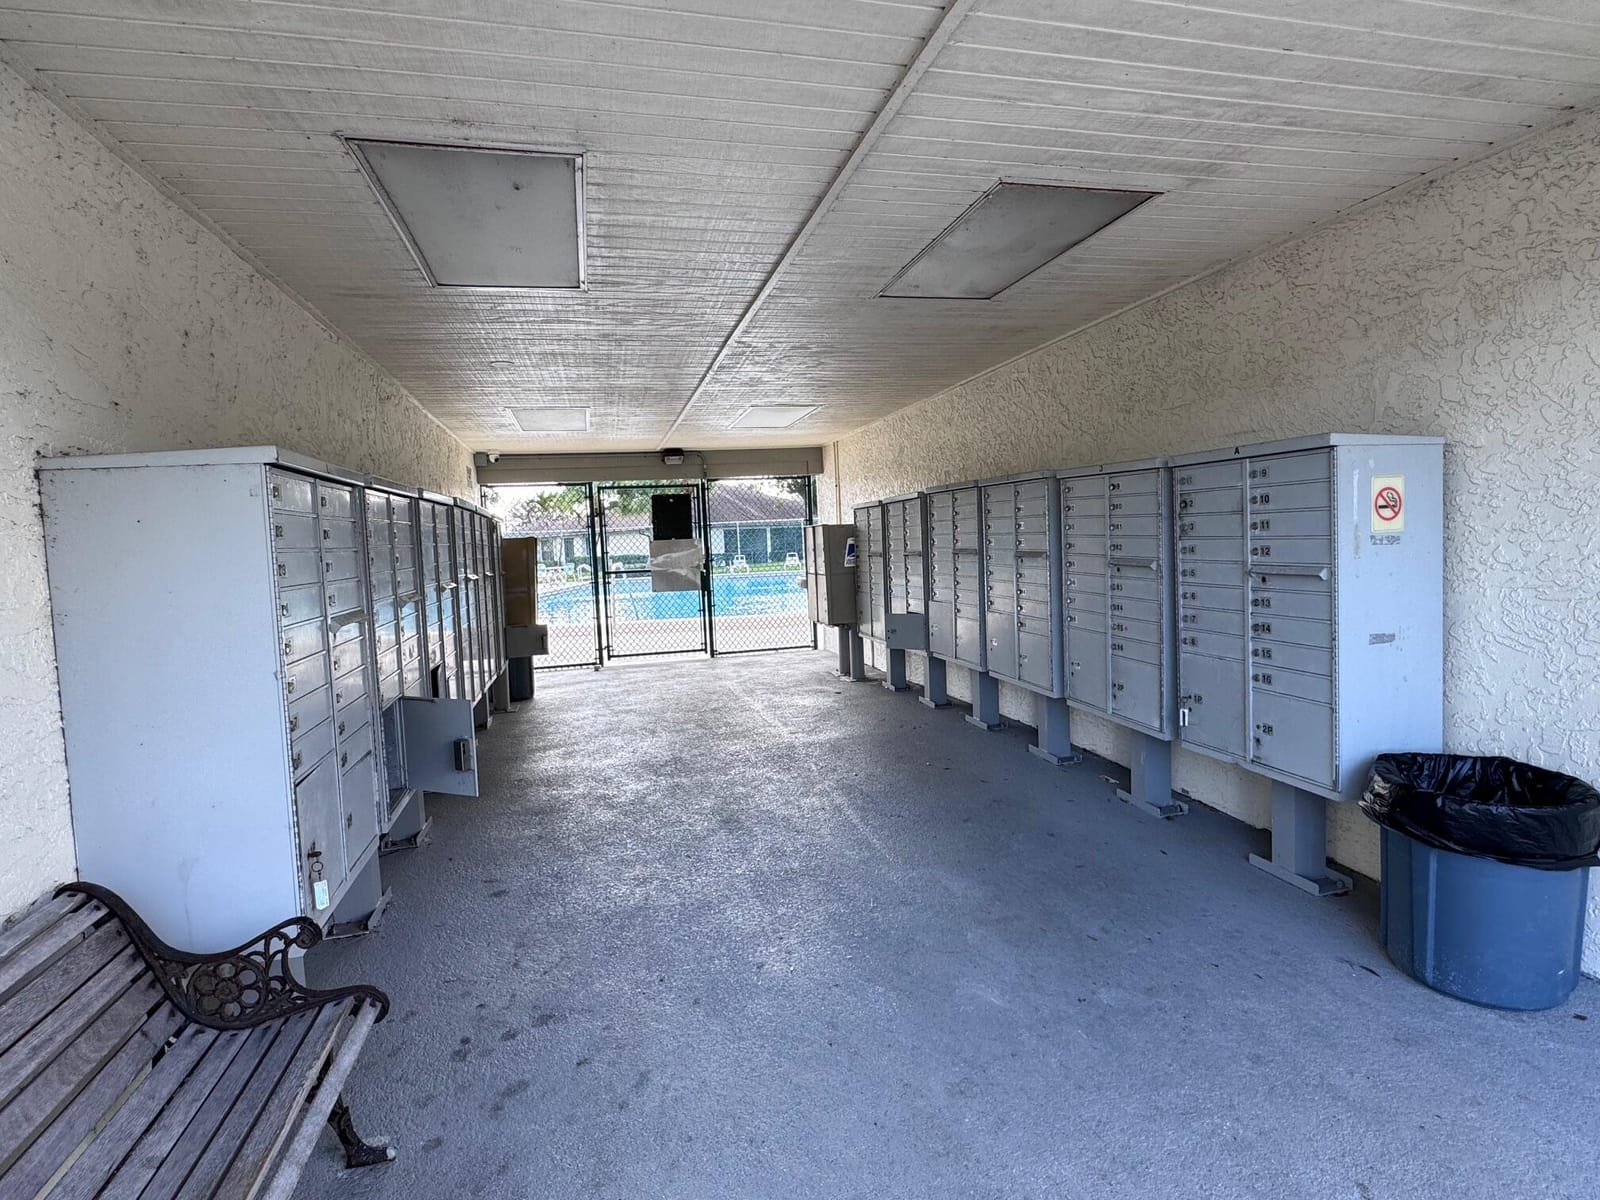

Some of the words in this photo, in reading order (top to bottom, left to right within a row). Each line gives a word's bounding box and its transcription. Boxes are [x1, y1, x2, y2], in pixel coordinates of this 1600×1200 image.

[1233, 446, 1240, 455] A
[1261, 469, 1267, 477] 9
[1260, 495, 1270, 504] 10
[1260, 520, 1269, 529] 11
[1260, 547, 1271, 556] 12
[1261, 598, 1271, 607] 13
[1261, 624, 1271, 633] 14
[1261, 649, 1272, 658] 15
[1261, 674, 1272, 684] 16
[1262, 725, 1273, 735] 2P
